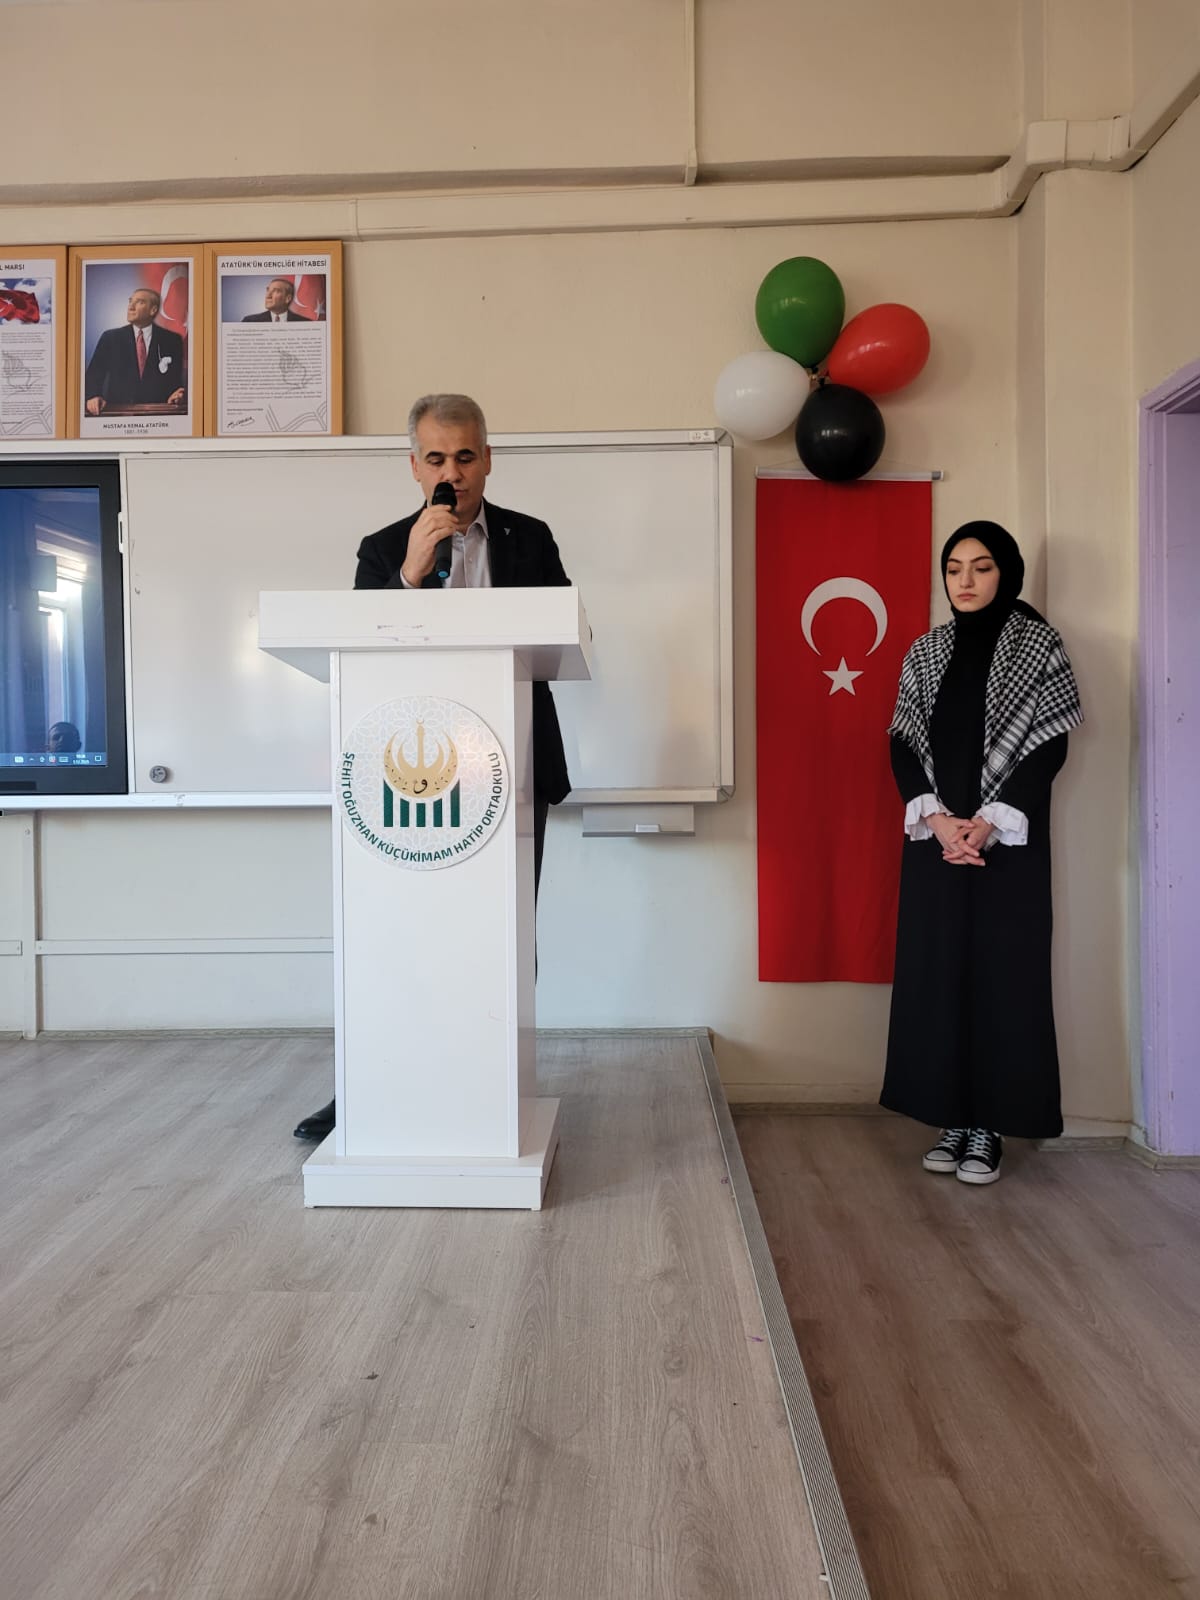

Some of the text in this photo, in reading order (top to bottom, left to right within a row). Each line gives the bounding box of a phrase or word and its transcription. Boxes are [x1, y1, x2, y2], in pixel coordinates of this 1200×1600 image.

[221, 259, 327, 268] ATATÜRK'ÜN GENÇLİĞE HİTABESİ
[341, 752, 503, 862] ŞEHİT OĞUZHAN KÜÇÜKİMAM HATİP ORTAOKULU
